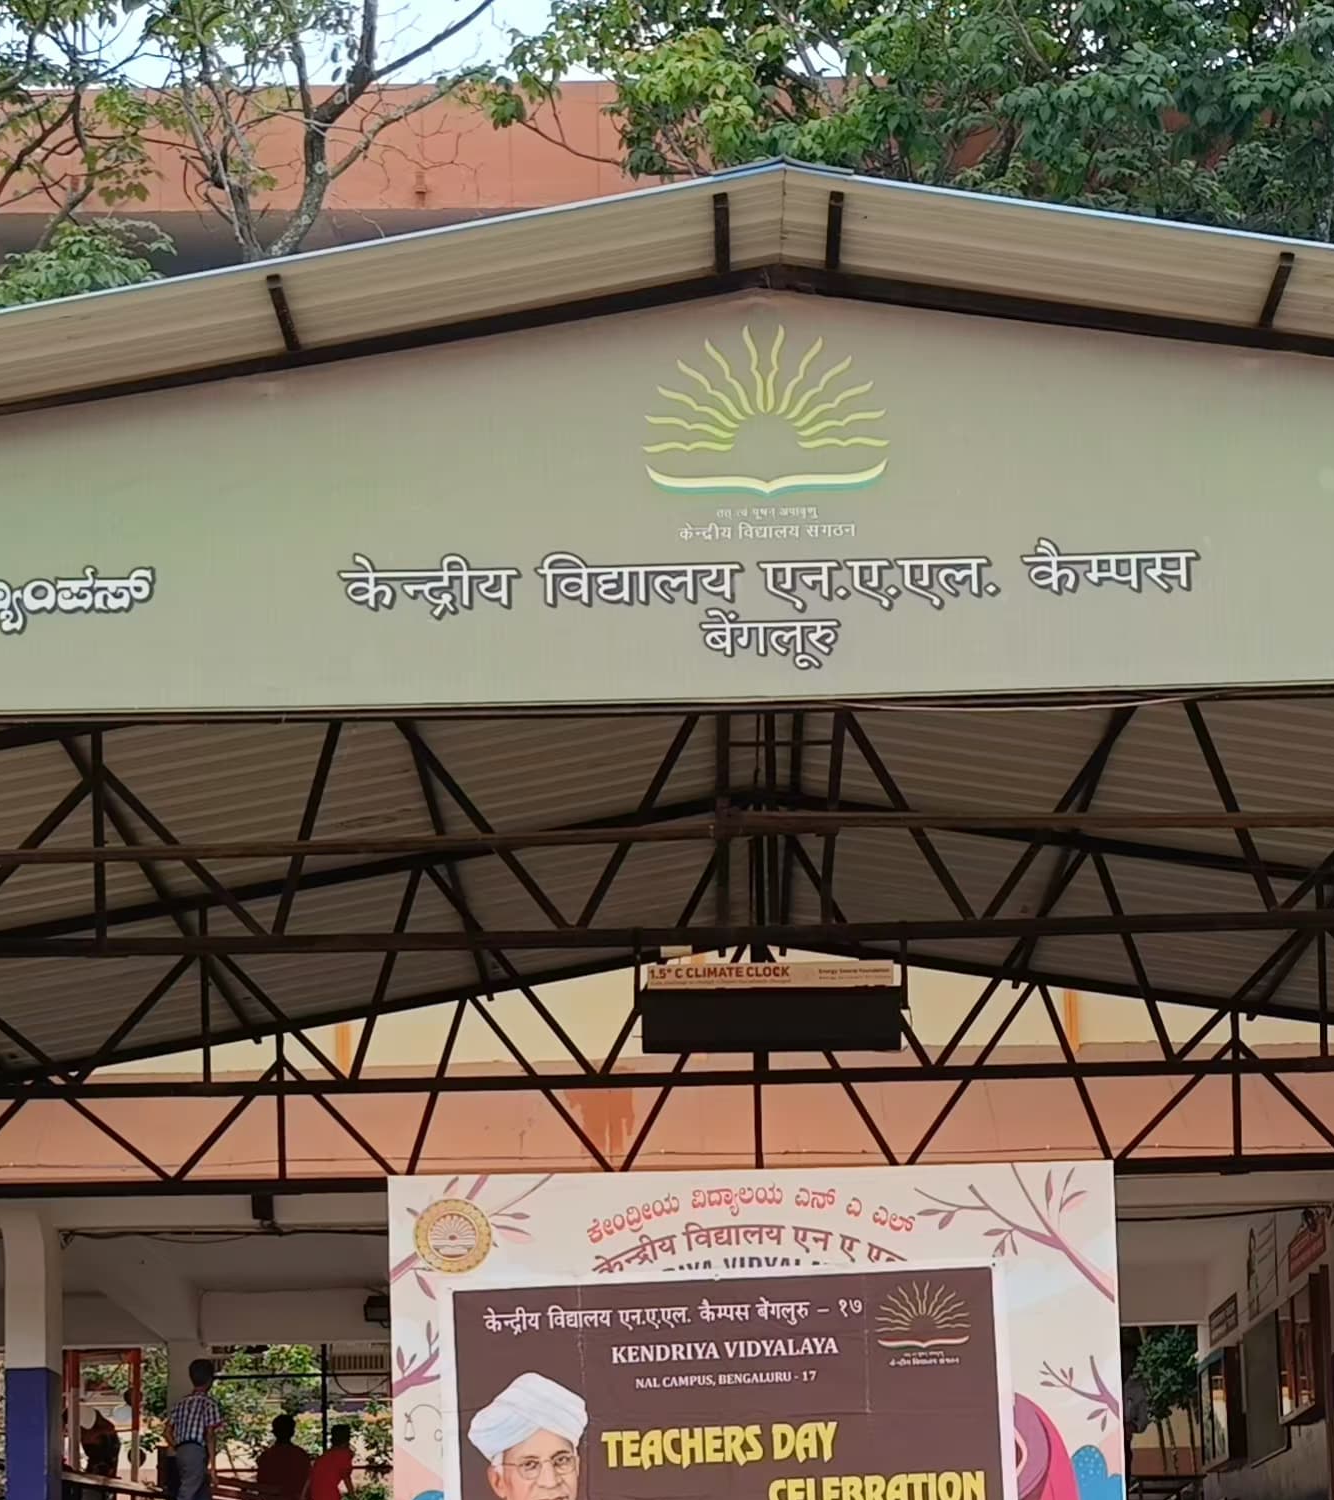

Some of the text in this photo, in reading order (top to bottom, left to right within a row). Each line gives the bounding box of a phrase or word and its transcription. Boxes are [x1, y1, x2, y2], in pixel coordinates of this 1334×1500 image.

[679, 522, 732, 541] केन्द्रीय
[739, 521, 800, 539] विद्यालय
[338, 539, 1201, 620] केन्द्रीय विद्यालय एन.ए.एल. कैम्पस
[700, 608, 841, 670] बेंगलूरु
[675, 967, 684, 979] C
[686, 966, 744, 979] CLIMATE
[747, 965, 791, 977] CLOCK
[586, 1193, 680, 1243] ಕೇಂದ್ರೀಯ
[691, 1183, 784, 1217] ವಿದ್ಯಾಲಯ
[794, 1187, 836, 1209] ಎನ್
[872, 1206, 916, 1233] ಎಲ್
[682, 1222, 786, 1251] विद्यालय
[792, 1226, 834, 1254] एन
[839, 1233, 861, 1263] ए
[483, 1306, 542, 1335] केन्द्रीय
[547, 1305, 613, 1330] विद्यालय
[617, 1306, 692, 1331] एन.ए.एल.
[698, 1299, 751, 1324] कैम्पस
[838, 1298, 863, 1318] १७
[611, 1336, 840, 1364] KENDRIYA VIDYALAYA
[635, 1377, 660, 1389] NAL
[662, 1374, 716, 1388] CAMPUS,
[718, 1371, 792, 1385] BENGALURU
[802, 1370, 817, 1382] 17
[601, 1421, 838, 1471] TEACHERS DAY
